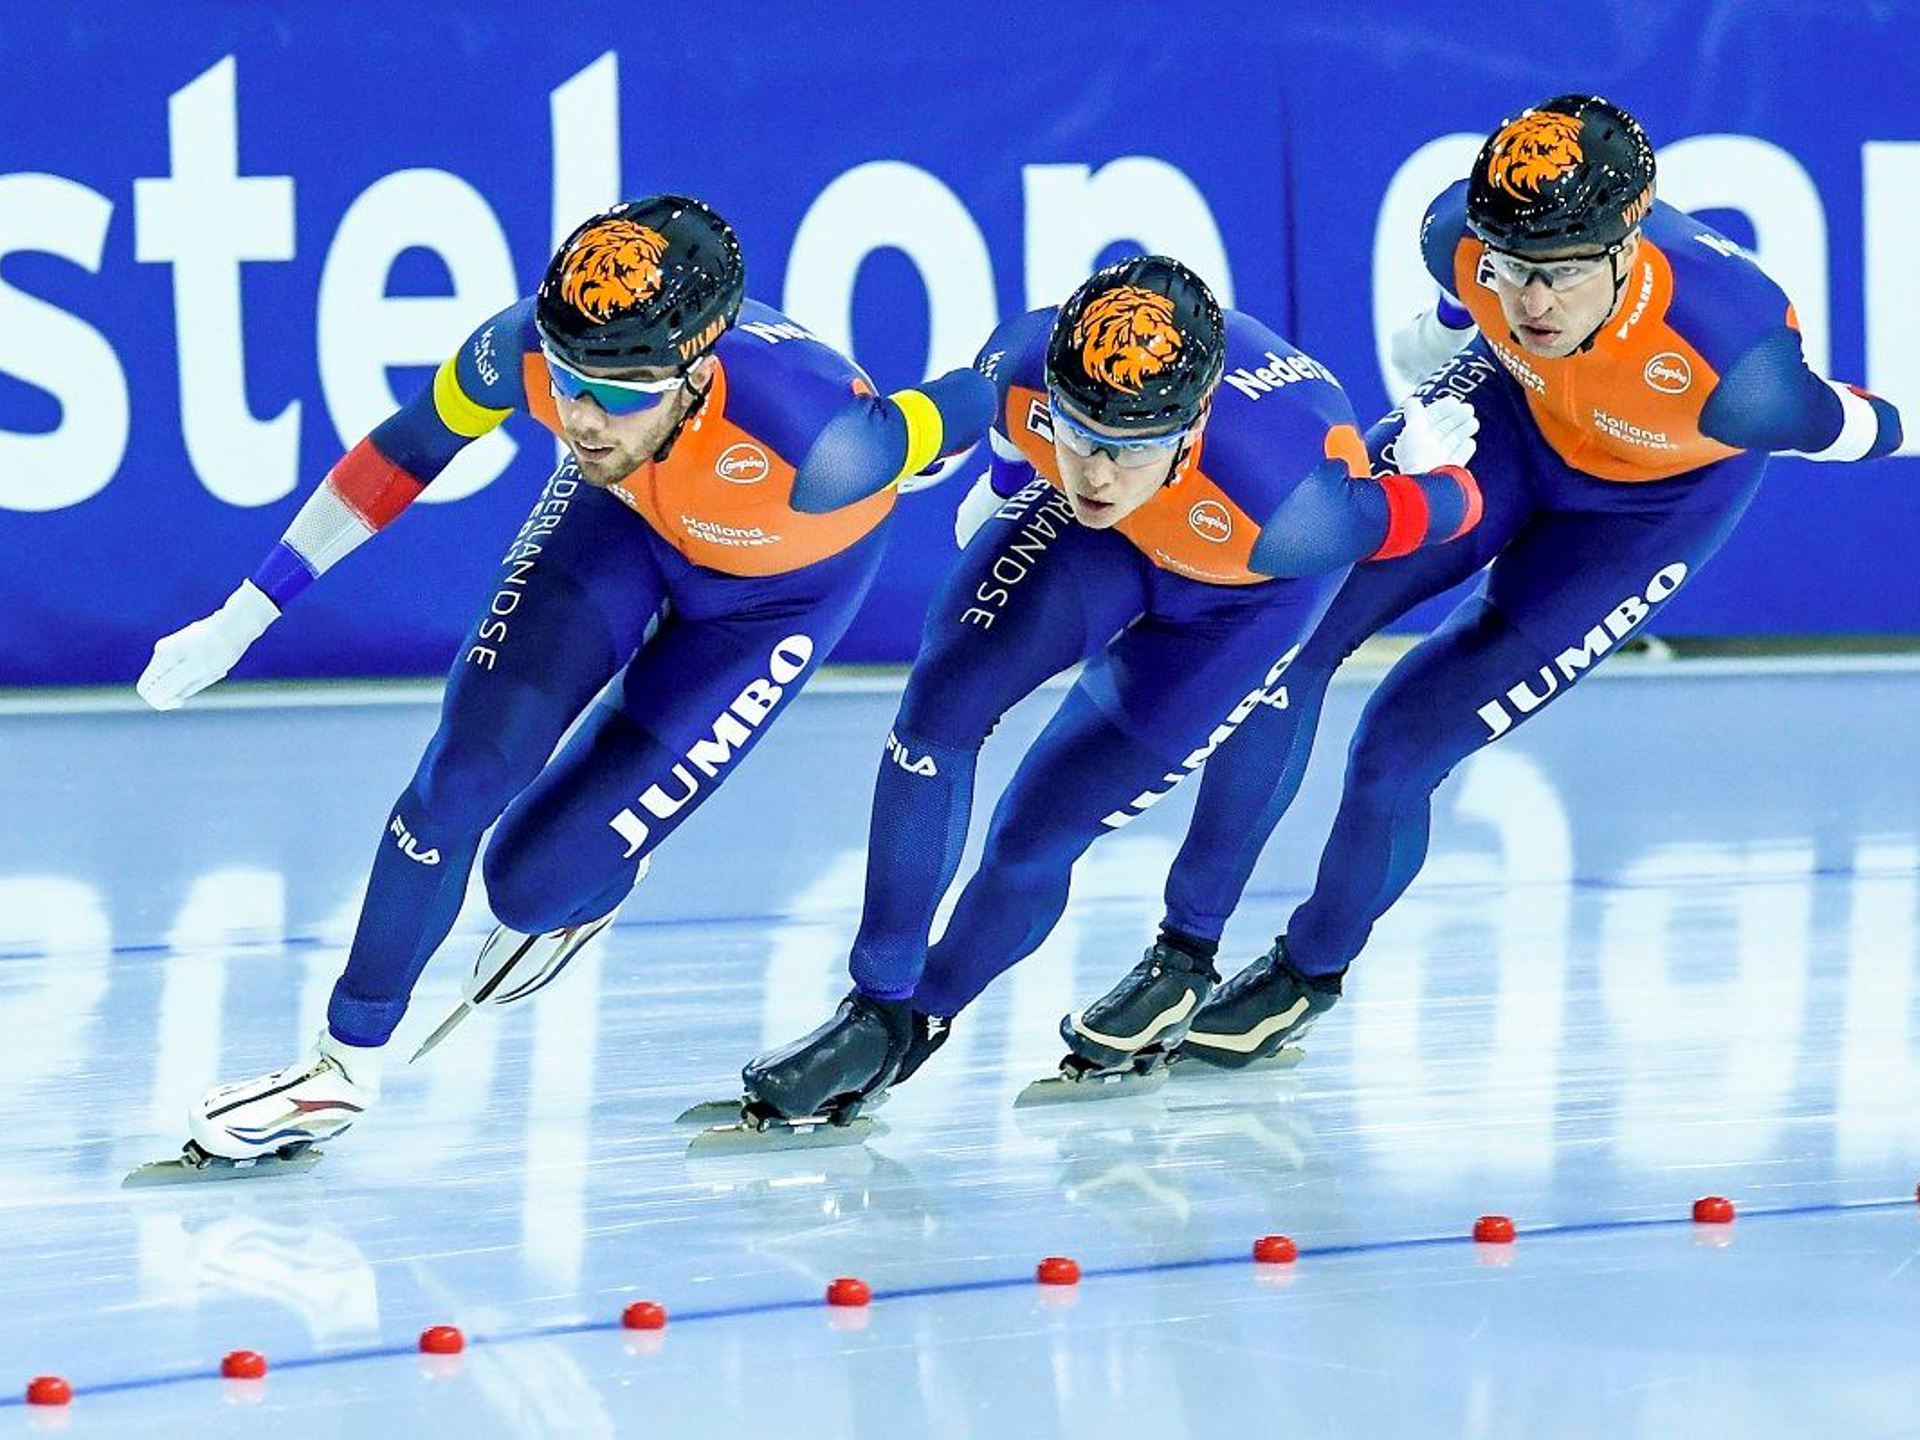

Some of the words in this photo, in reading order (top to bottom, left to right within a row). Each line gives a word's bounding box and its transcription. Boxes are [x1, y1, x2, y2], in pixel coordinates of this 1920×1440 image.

[1593, 408, 1667, 443] Holland
[680, 514, 764, 539] Holland
[1476, 561, 1688, 741] JUMBO
[608, 633, 814, 859] JUMBO
[886, 731, 938, 777] FILA
[389, 814, 441, 866] FILA
